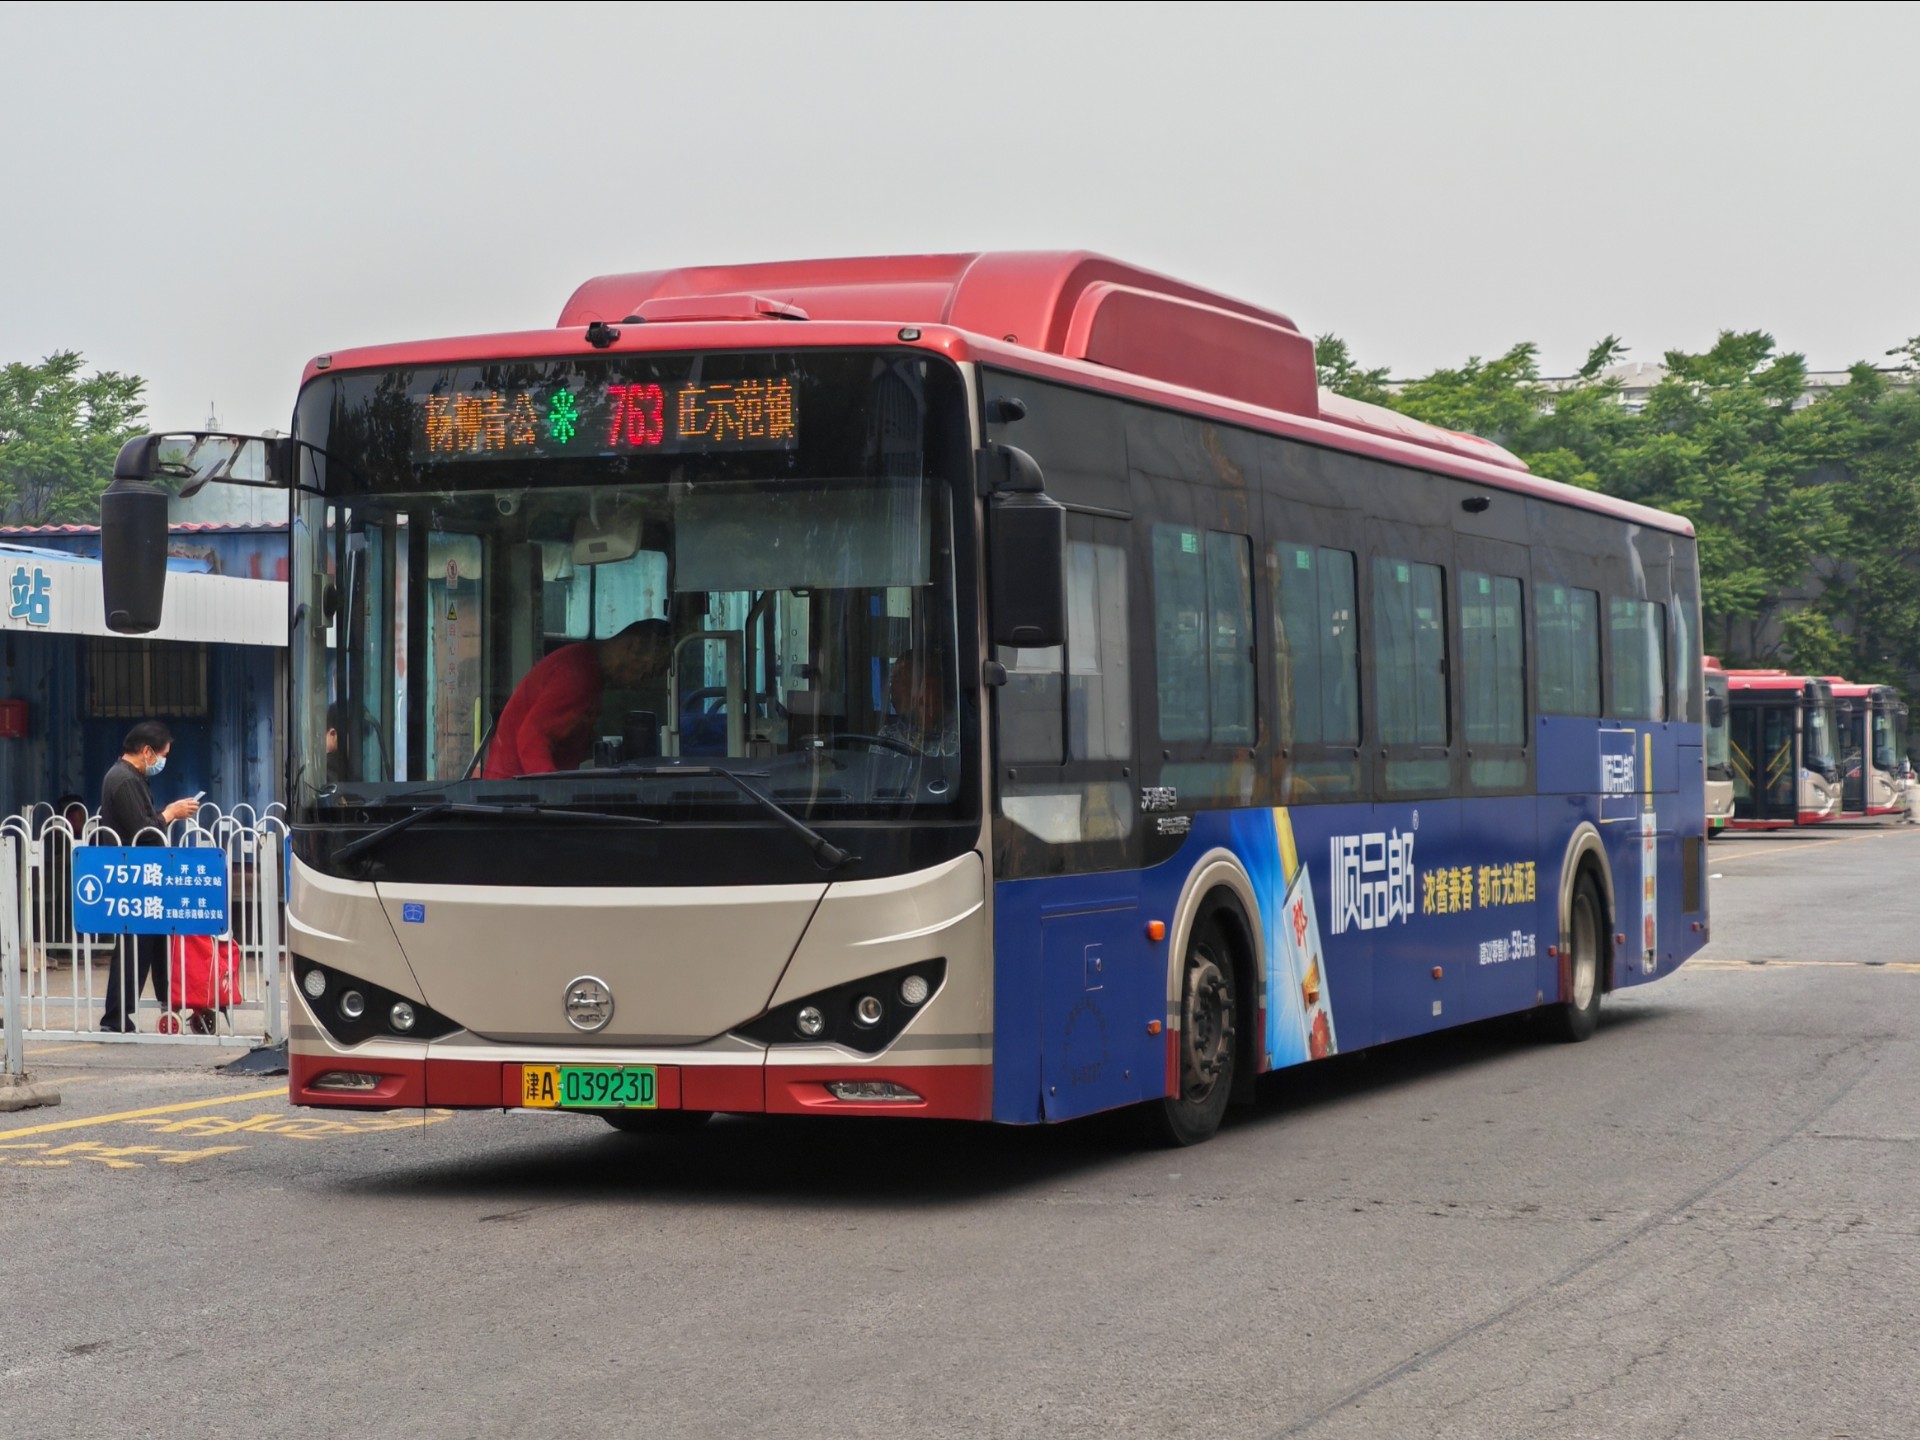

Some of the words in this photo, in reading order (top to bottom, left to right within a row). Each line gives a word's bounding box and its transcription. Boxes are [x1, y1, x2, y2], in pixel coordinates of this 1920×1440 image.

[607, 383, 664, 446] 763
[678, 378, 795, 441] 庄示范镇
[10, 566, 51, 624] 站
[104, 863, 163, 887] 757路
[1331, 827, 1414, 935] 顺品郎
[104, 896, 164, 920] 763路
